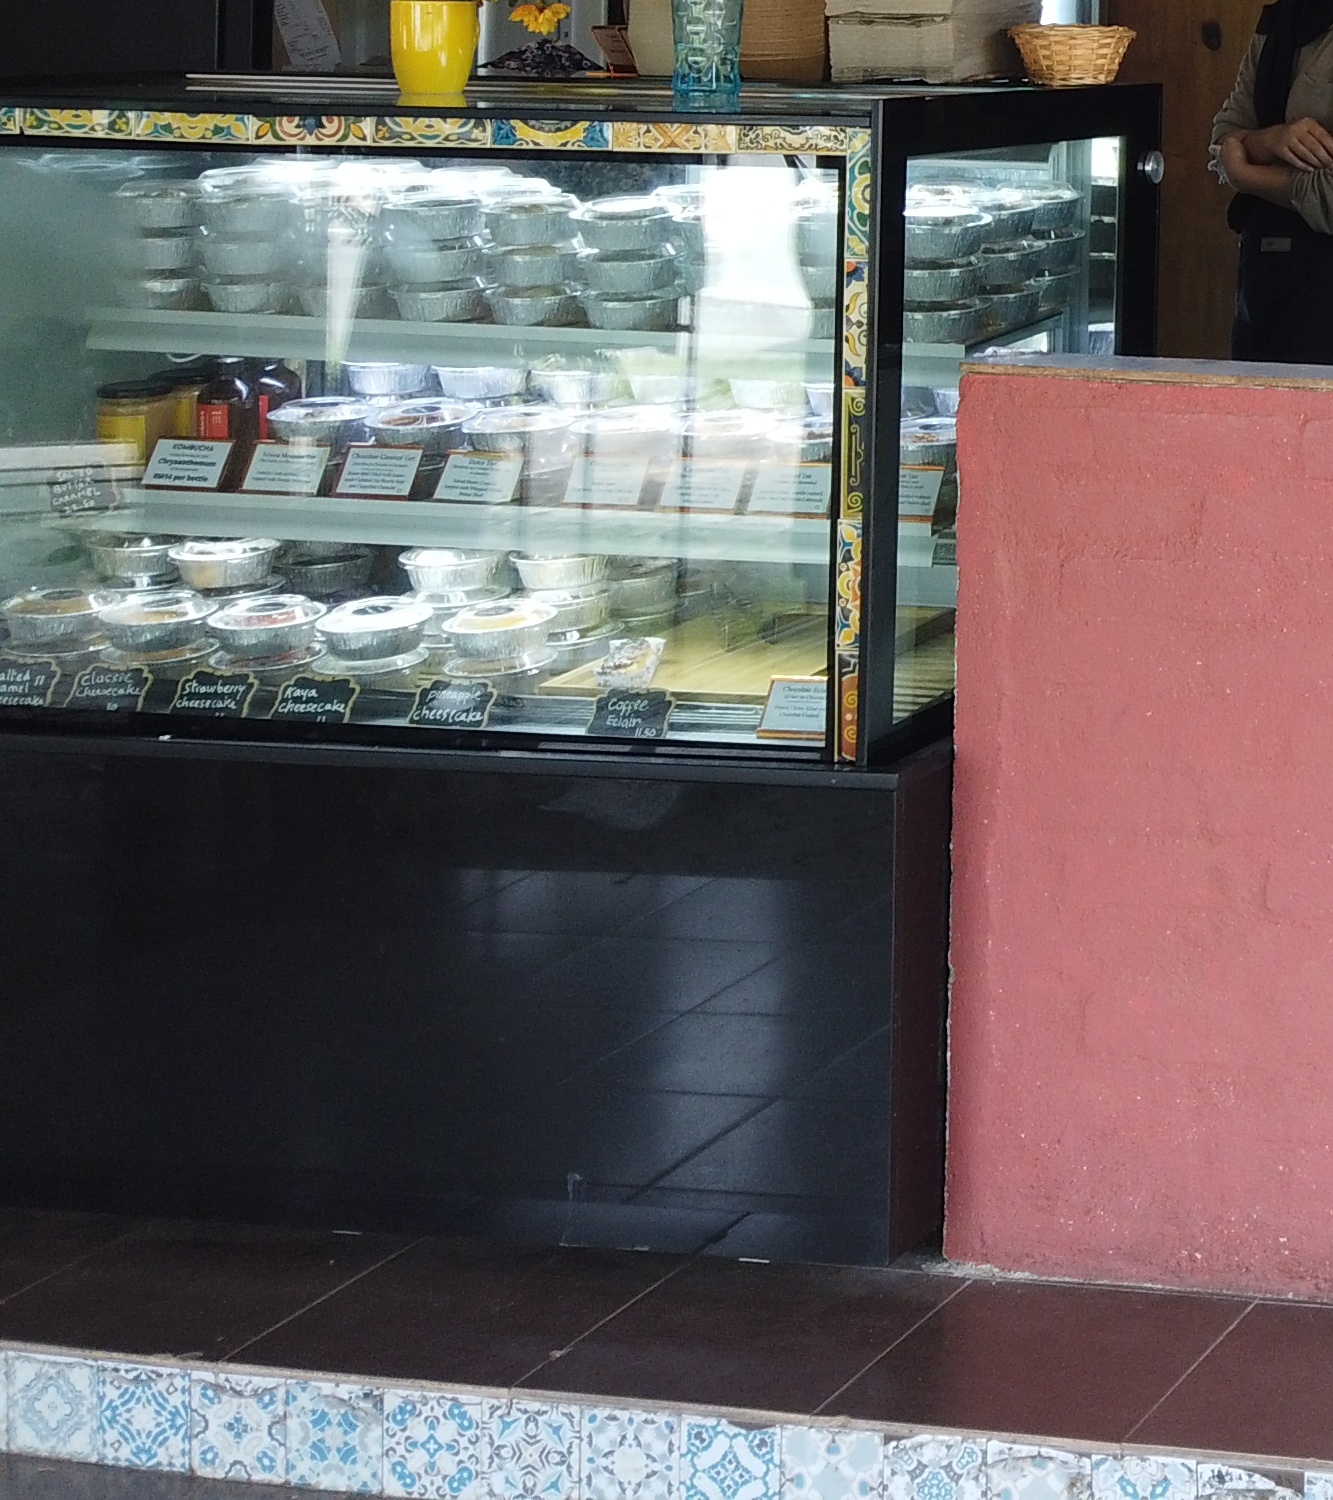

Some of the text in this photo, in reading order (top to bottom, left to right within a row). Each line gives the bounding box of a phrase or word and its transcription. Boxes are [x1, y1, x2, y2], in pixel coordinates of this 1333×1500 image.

[0, 668, 31, 682] alted
[0, 682, 29, 693] amel
[607, 697, 650, 716] Coffee
[605, 715, 642, 729] Eclair
